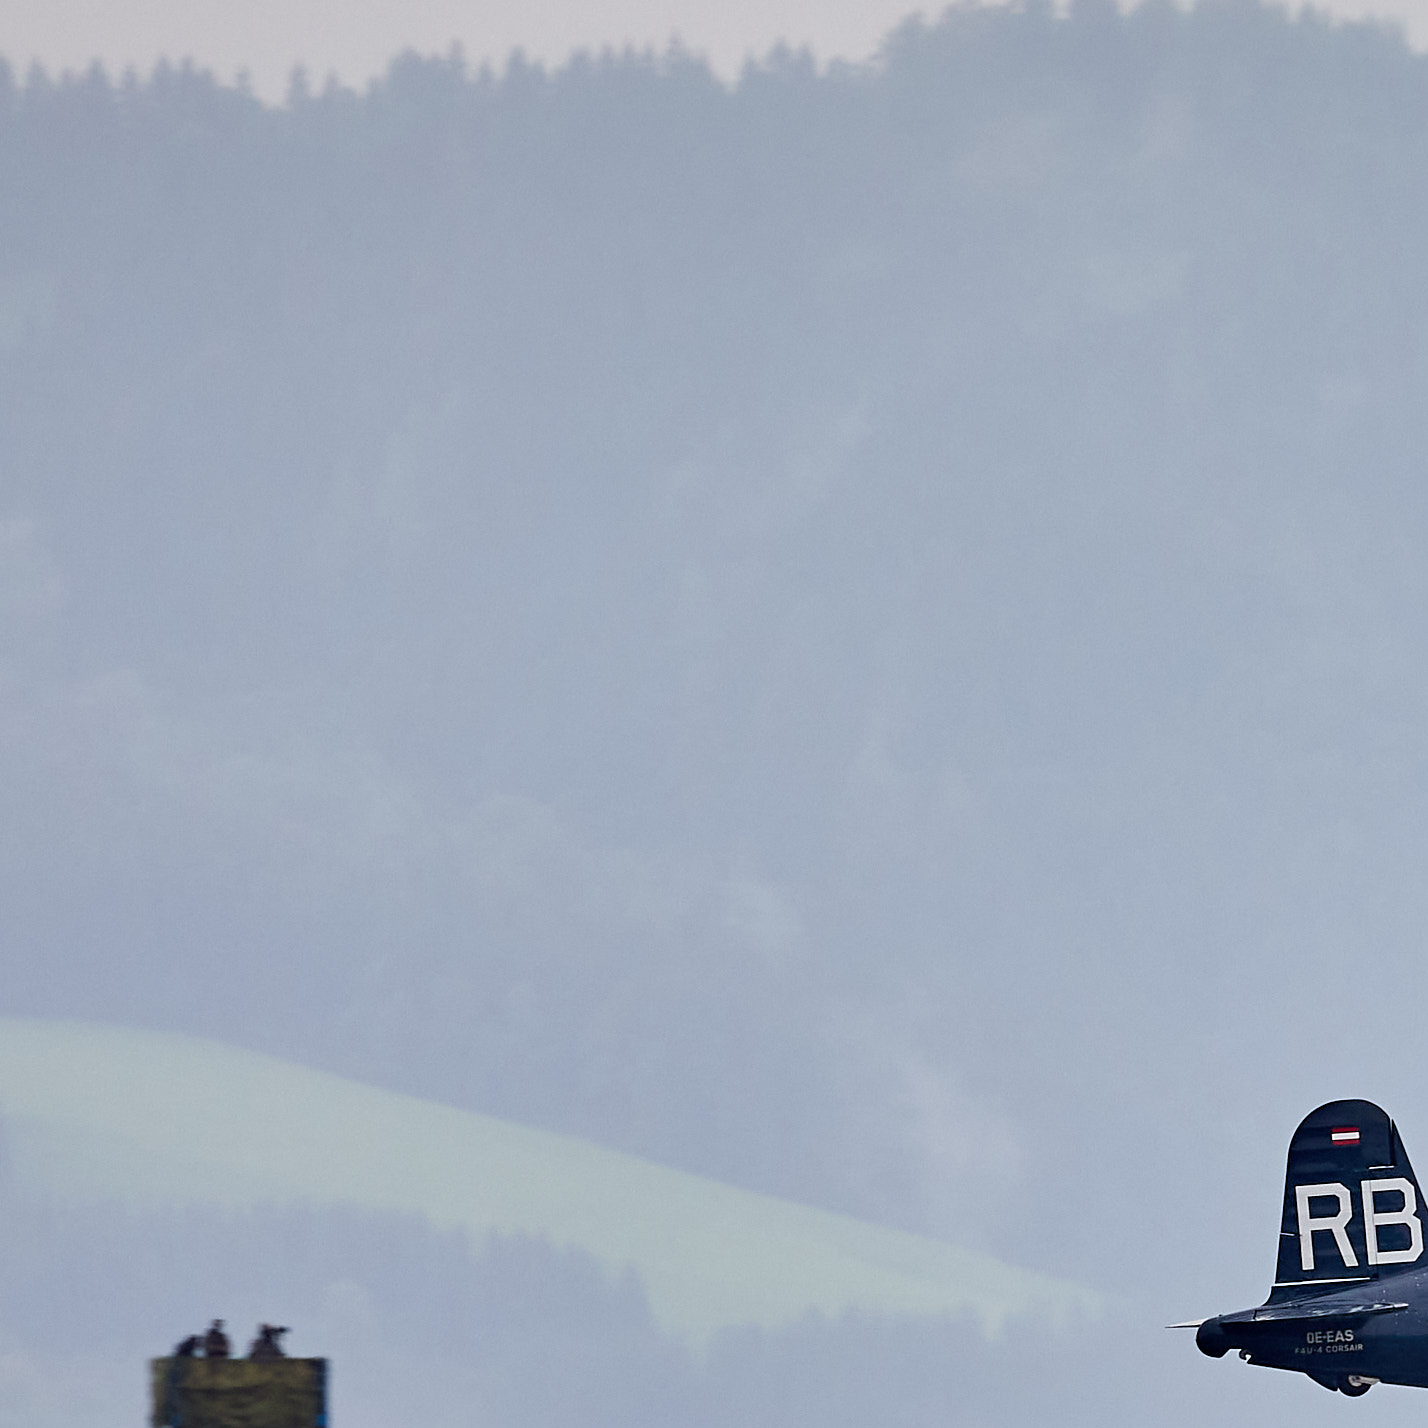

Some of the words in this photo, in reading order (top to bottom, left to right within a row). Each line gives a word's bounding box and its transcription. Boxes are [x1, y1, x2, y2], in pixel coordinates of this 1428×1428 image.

[1294, 1177, 1424, 1271] RB
[1306, 1329, 1354, 1344] OE-EAS
[1325, 1343, 1364, 1353] CORSAIR
